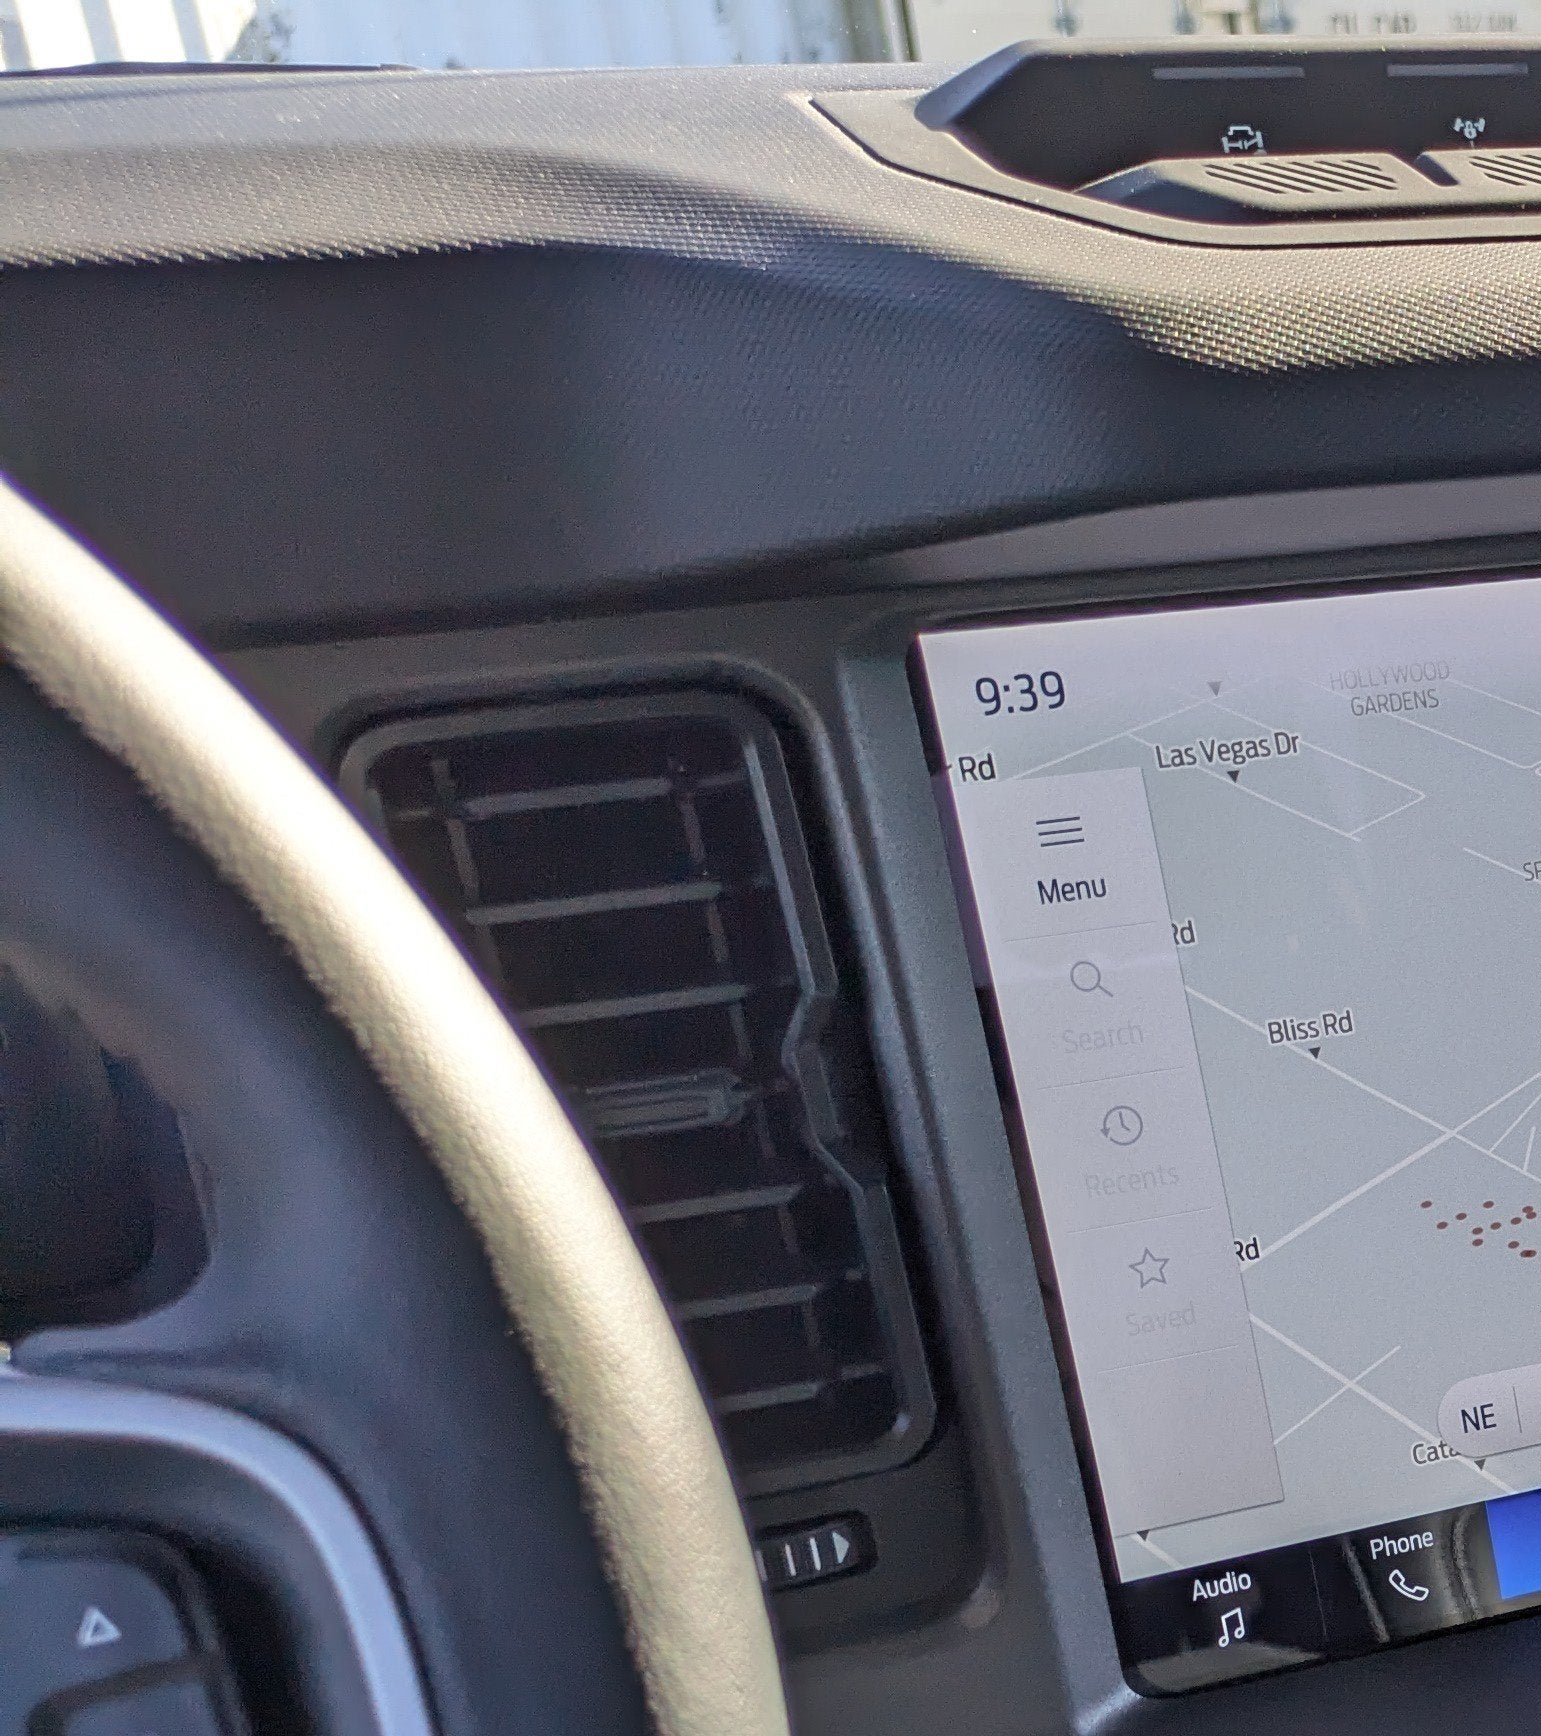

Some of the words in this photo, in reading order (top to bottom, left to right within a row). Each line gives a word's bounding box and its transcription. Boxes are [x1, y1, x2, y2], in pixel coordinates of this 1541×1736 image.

[1330, 660, 1451, 691] HOLLYWOOD
[975, 670, 1067, 716] 9:39
[1350, 688, 1440, 718] GARDENS
[1156, 744, 1197, 769] Las
[1199, 736, 1270, 766] Vegas
[1274, 731, 1300, 756] Dr
[958, 752, 996, 782] Rd
[1036, 878, 1108, 905] Menu
[1061, 1020, 1145, 1054] Search
[1268, 1018, 1318, 1045] Bliss
[1322, 1009, 1354, 1037] Rd
[1461, 1403, 1498, 1434] NE
[1369, 1530, 1435, 1561] Phone
[1191, 1570, 1253, 1602] Audio
